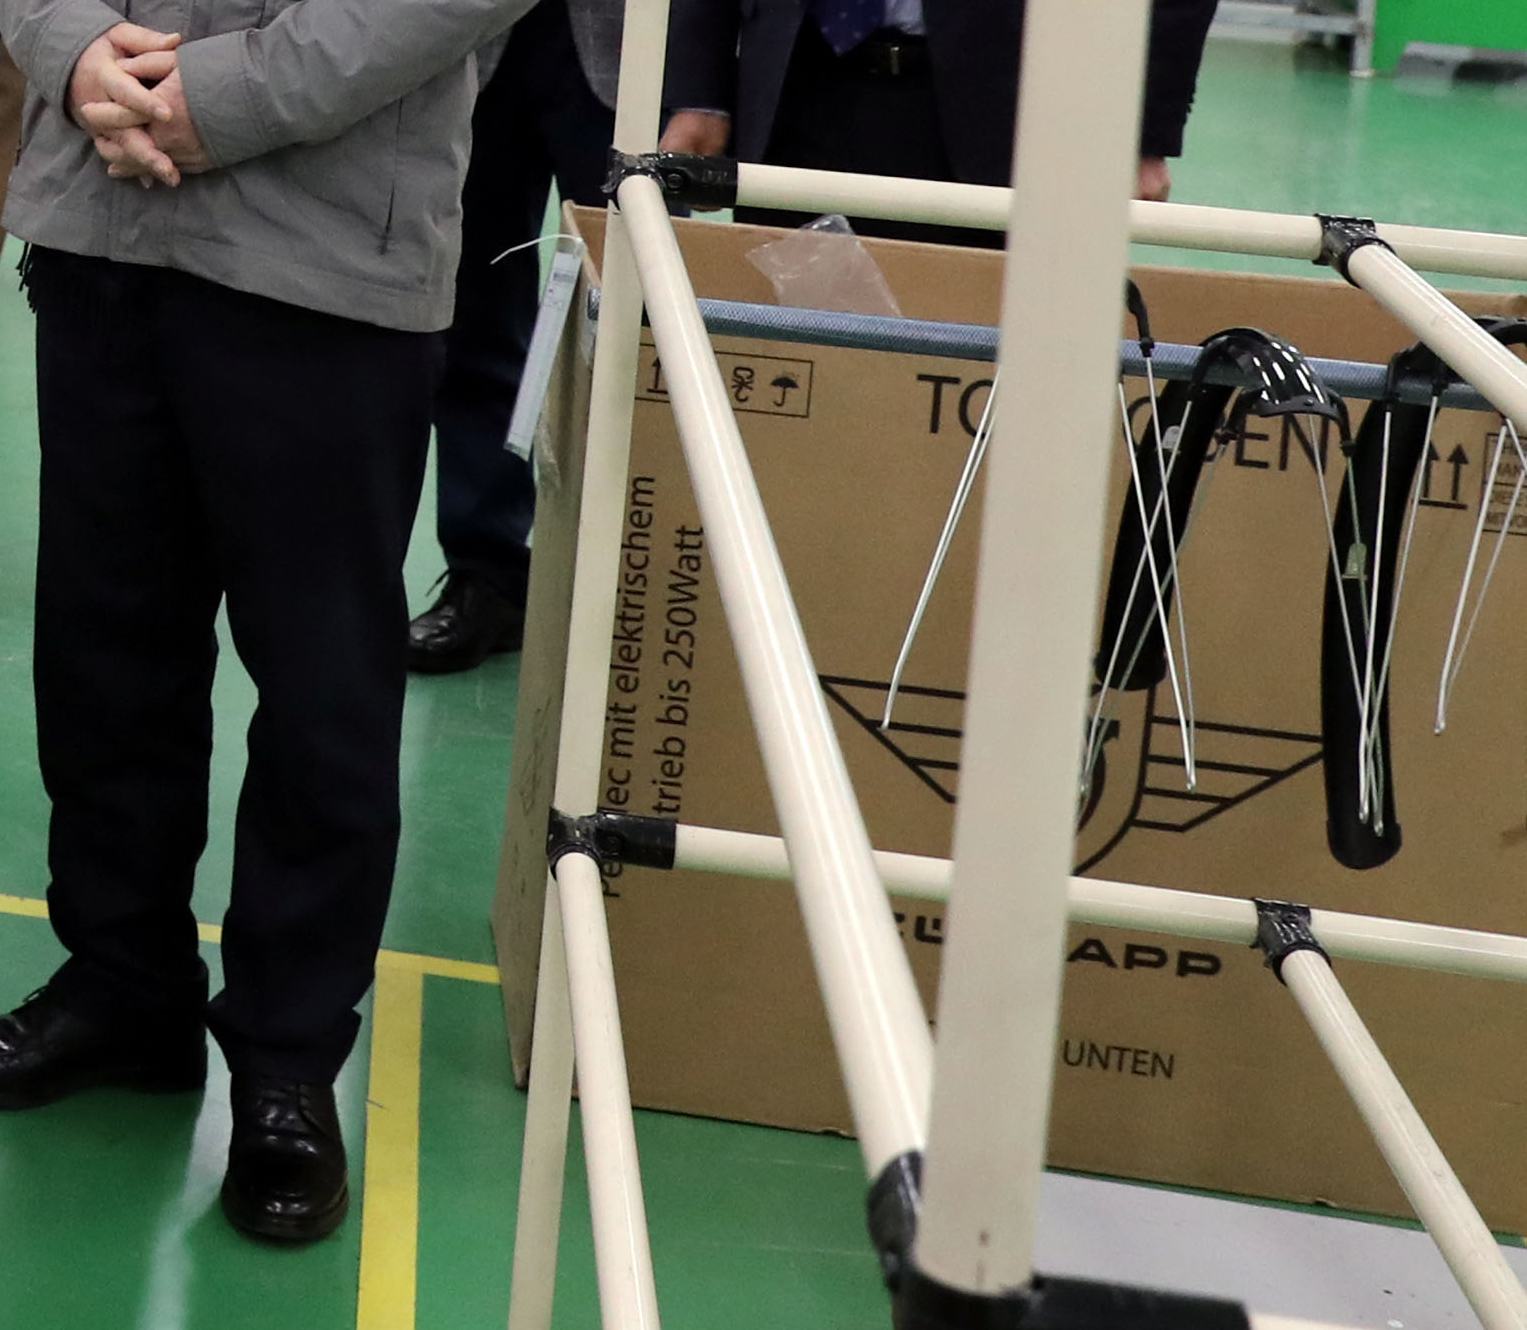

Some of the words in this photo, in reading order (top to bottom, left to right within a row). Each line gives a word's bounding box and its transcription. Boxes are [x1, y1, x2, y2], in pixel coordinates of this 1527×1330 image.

[610, 474, 656, 695] elektrischem
[663, 524, 704, 670] 250Watt
[605, 702, 636, 759] mit
[655, 678, 691, 727] bis
[651, 736, 686, 816] trieb
[1063, 1039, 1175, 1079] UNTEN
